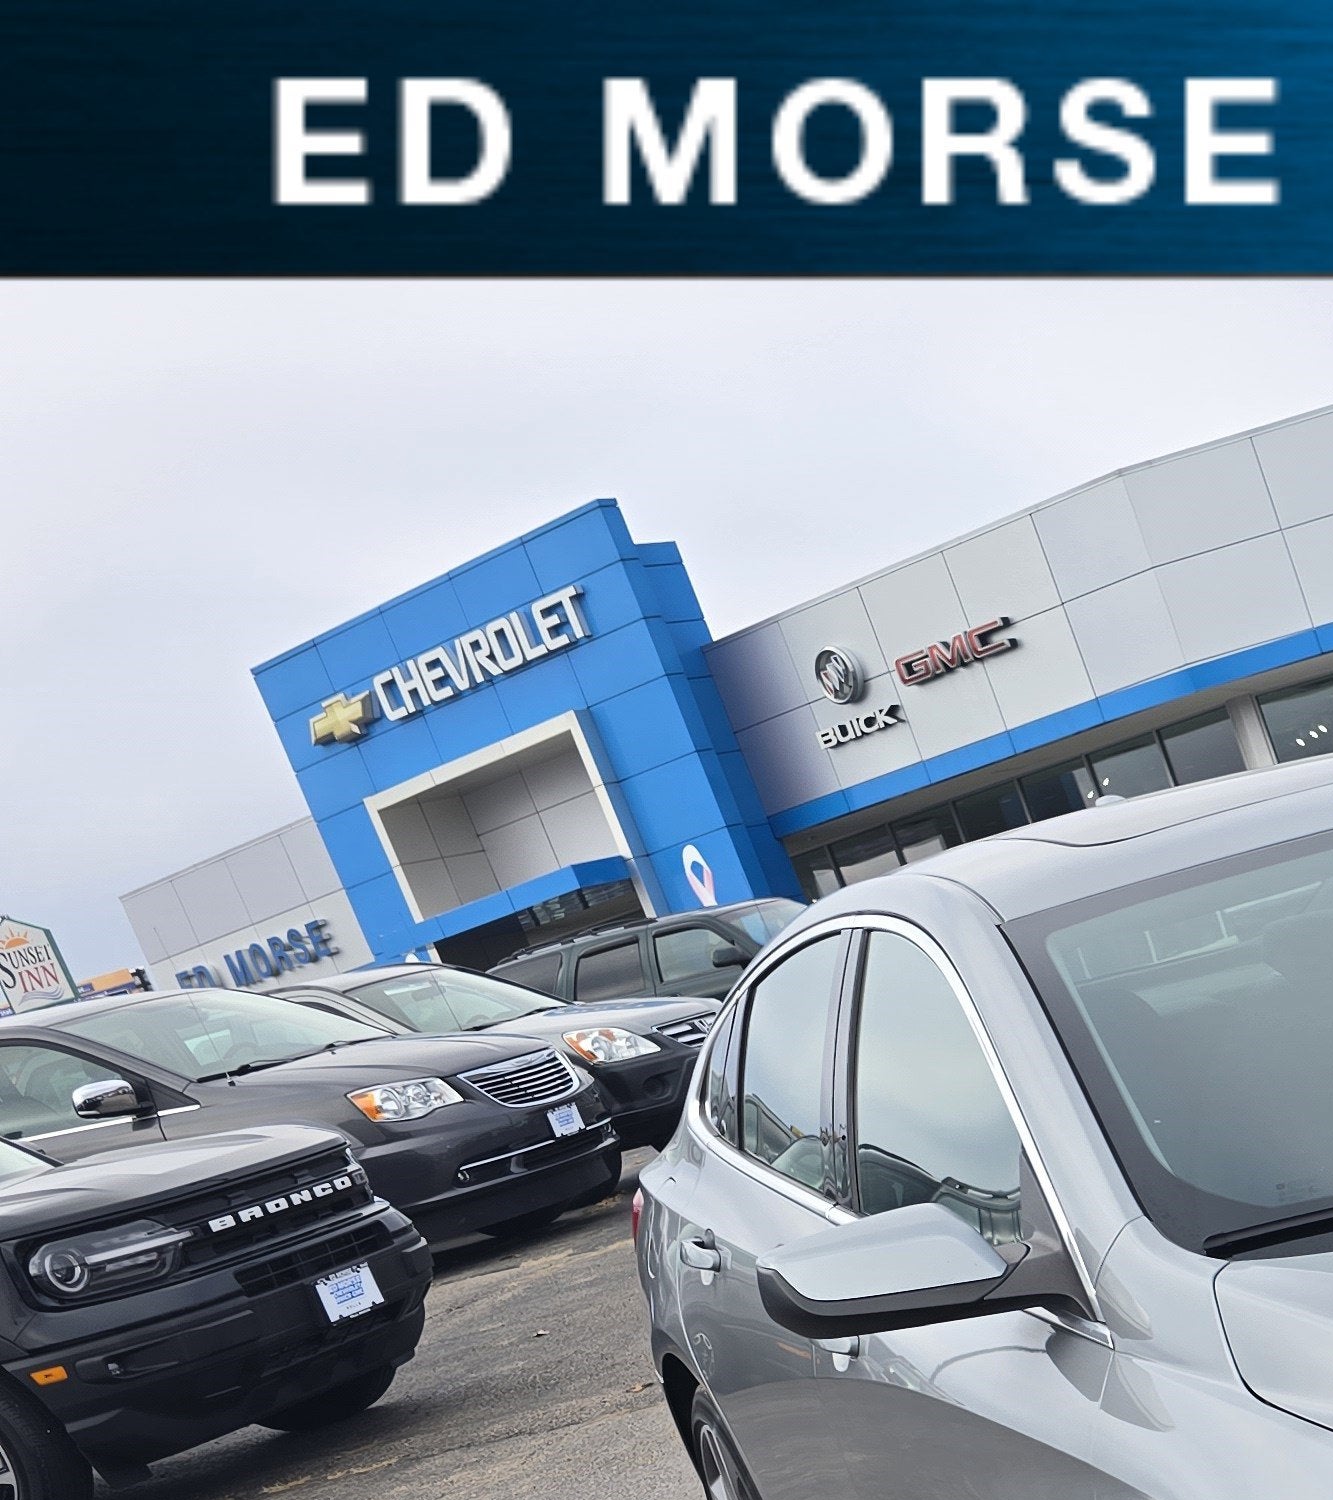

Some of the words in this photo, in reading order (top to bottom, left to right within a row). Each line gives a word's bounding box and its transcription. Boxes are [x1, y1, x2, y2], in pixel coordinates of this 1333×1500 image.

[373, 584, 590, 721] CHEVROLET
[895, 617, 1019, 687] GMC
[815, 704, 905, 751] BUICK
[0, 944, 52, 989] SUNSET
[18, 962, 60, 994] INN
[175, 964, 220, 990] ED
[223, 919, 340, 988] MORSE
[208, 1175, 352, 1233] BRONCO
